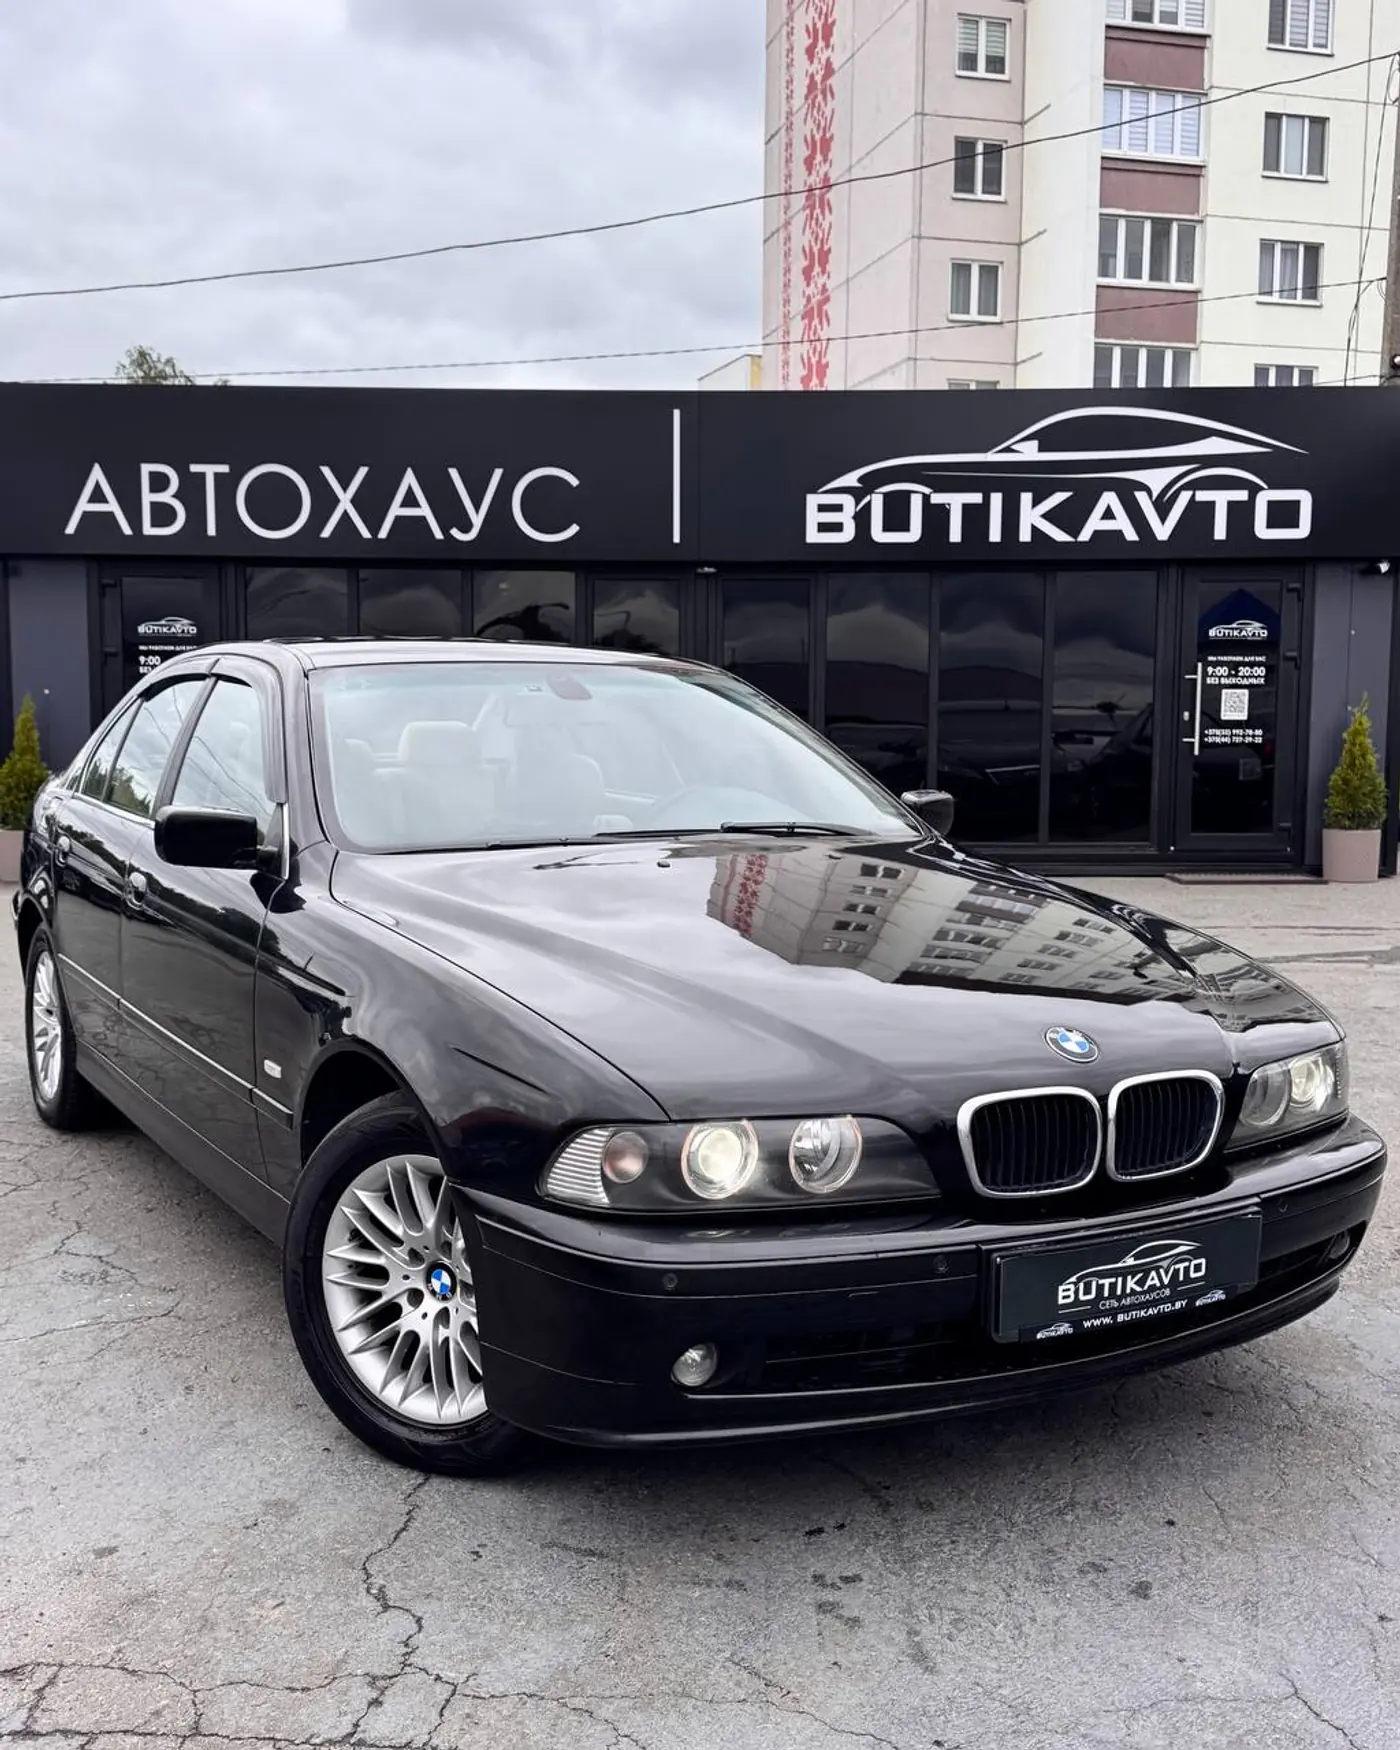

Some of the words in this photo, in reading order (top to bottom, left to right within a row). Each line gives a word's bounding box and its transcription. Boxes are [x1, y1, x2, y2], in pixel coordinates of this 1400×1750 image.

[64, 462, 581, 543] АВТОХАУС
[805, 488, 1312, 544] BUTIKAVTO
[137, 625, 197, 634] BUTIKAVTO
[1208, 629, 1268, 637] BUTIKAVTO
[1206, 677, 1219, 685] БЕЗ
[1220, 677, 1265, 685] ВЫХОДНЫХ
[1207, 666, 1229, 677] 9:00
[1238, 666, 1266, 677] 20:00
[1058, 1258, 1206, 1305] BUTIKAVTO
[1099, 1299, 1119, 1310] СЕТЬ
[1120, 1287, 1171, 1307] АВТОХАУСОВ
[1082, 1315, 1114, 1329] WWW.
[1116, 1299, 1188, 1323] BUTIKAVTO.BY
